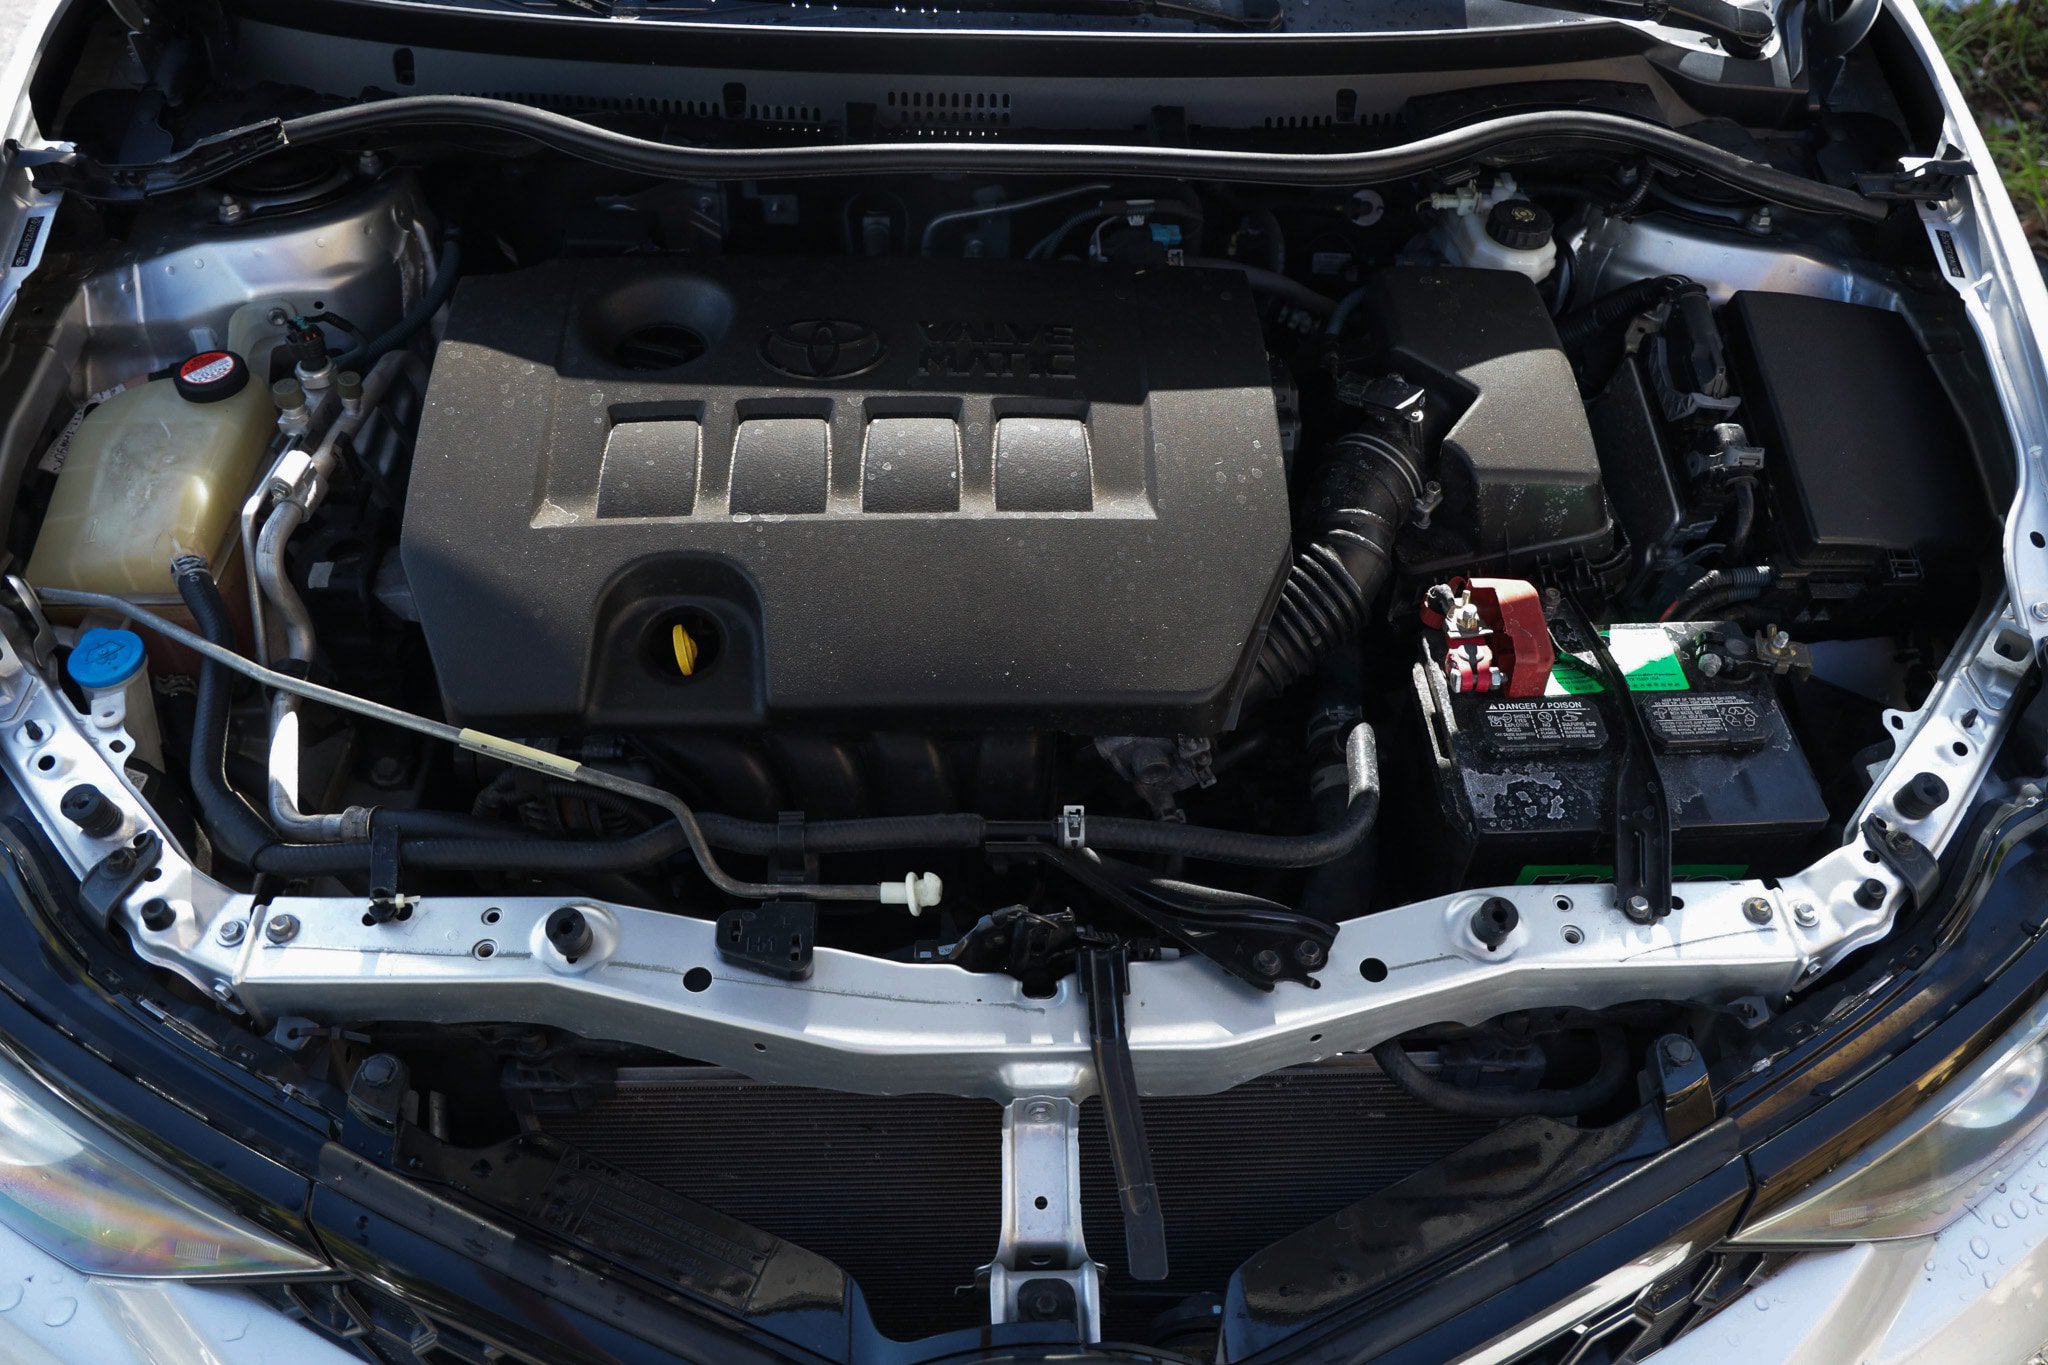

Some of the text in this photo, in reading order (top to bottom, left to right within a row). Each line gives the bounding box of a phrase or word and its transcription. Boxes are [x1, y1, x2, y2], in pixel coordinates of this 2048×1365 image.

[916, 321, 1074, 348] VALVE
[917, 352, 1076, 379] MATIC
[1547, 701, 1582, 709] POISON
